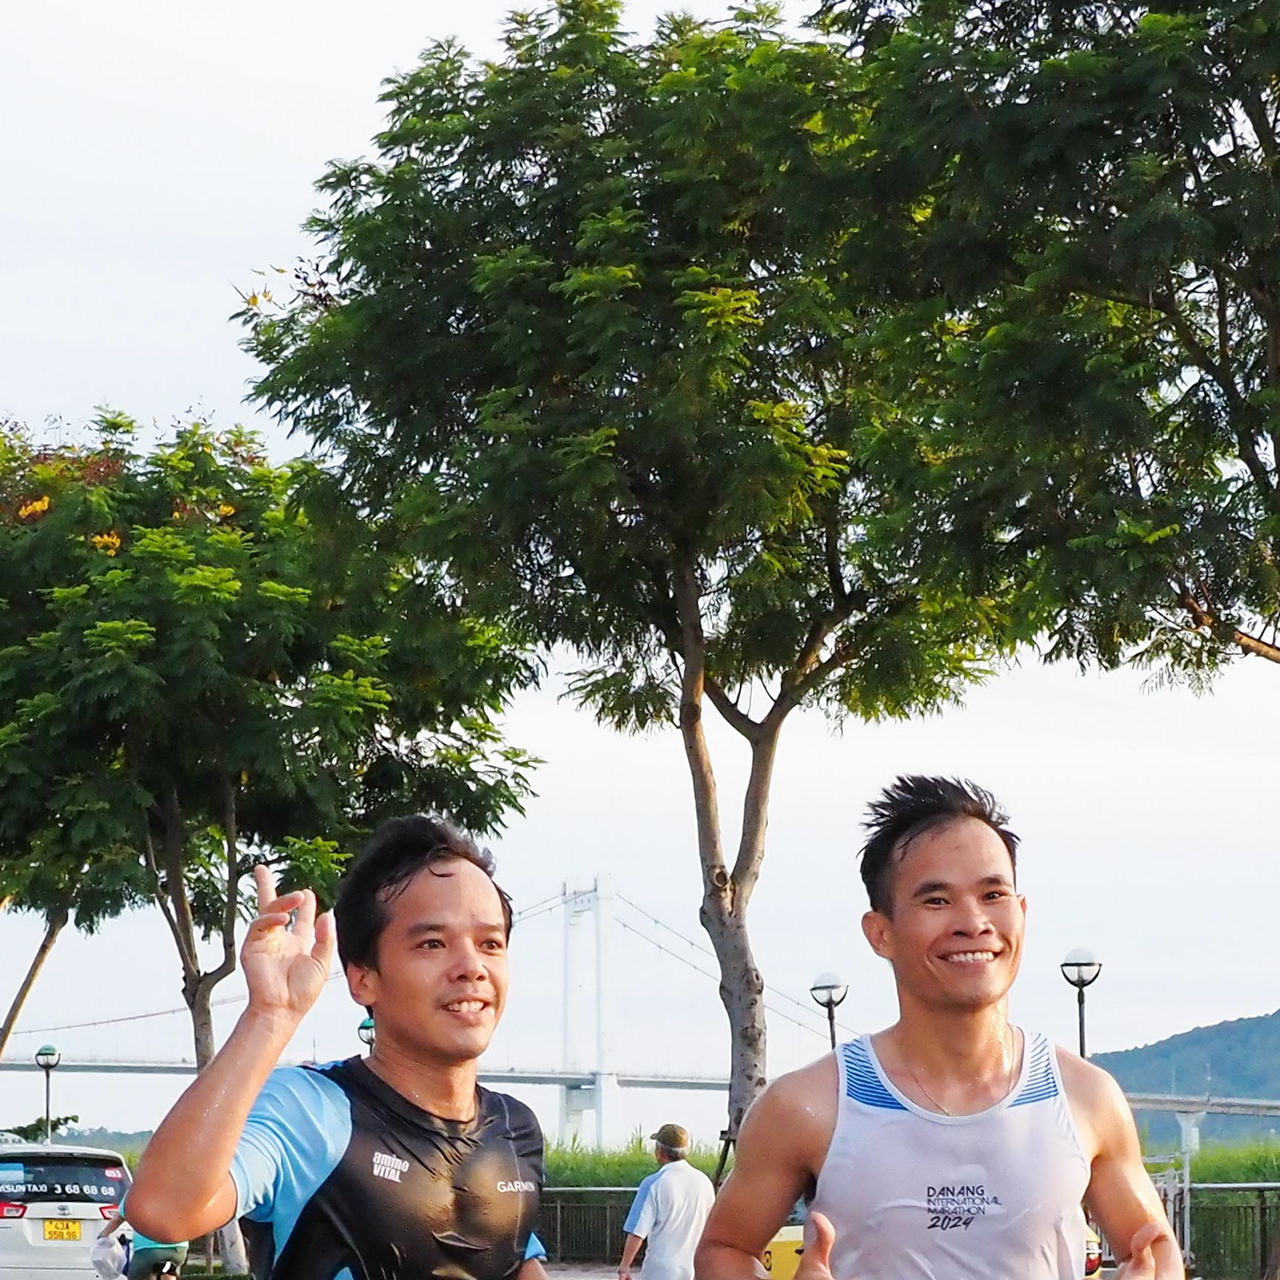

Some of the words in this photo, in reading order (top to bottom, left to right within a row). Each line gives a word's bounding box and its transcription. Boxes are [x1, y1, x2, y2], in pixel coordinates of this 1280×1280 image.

[372, 1151, 410, 1173] amino
[372, 1163, 402, 1183] VITAL
[26, 1183, 48, 1193] TAXI
[54, 1183, 62, 1194] 3
[65, 1184, 80, 1195] 68
[82, 1184, 98, 1195] 68
[100, 1186, 115, 1197] 68
[927, 1185, 985, 1198] DANANG
[927, 1196, 1002, 1206] INTERNATIONAL
[927, 1206, 986, 1216] MARATHON
[927, 1215, 975, 1231] 2024
